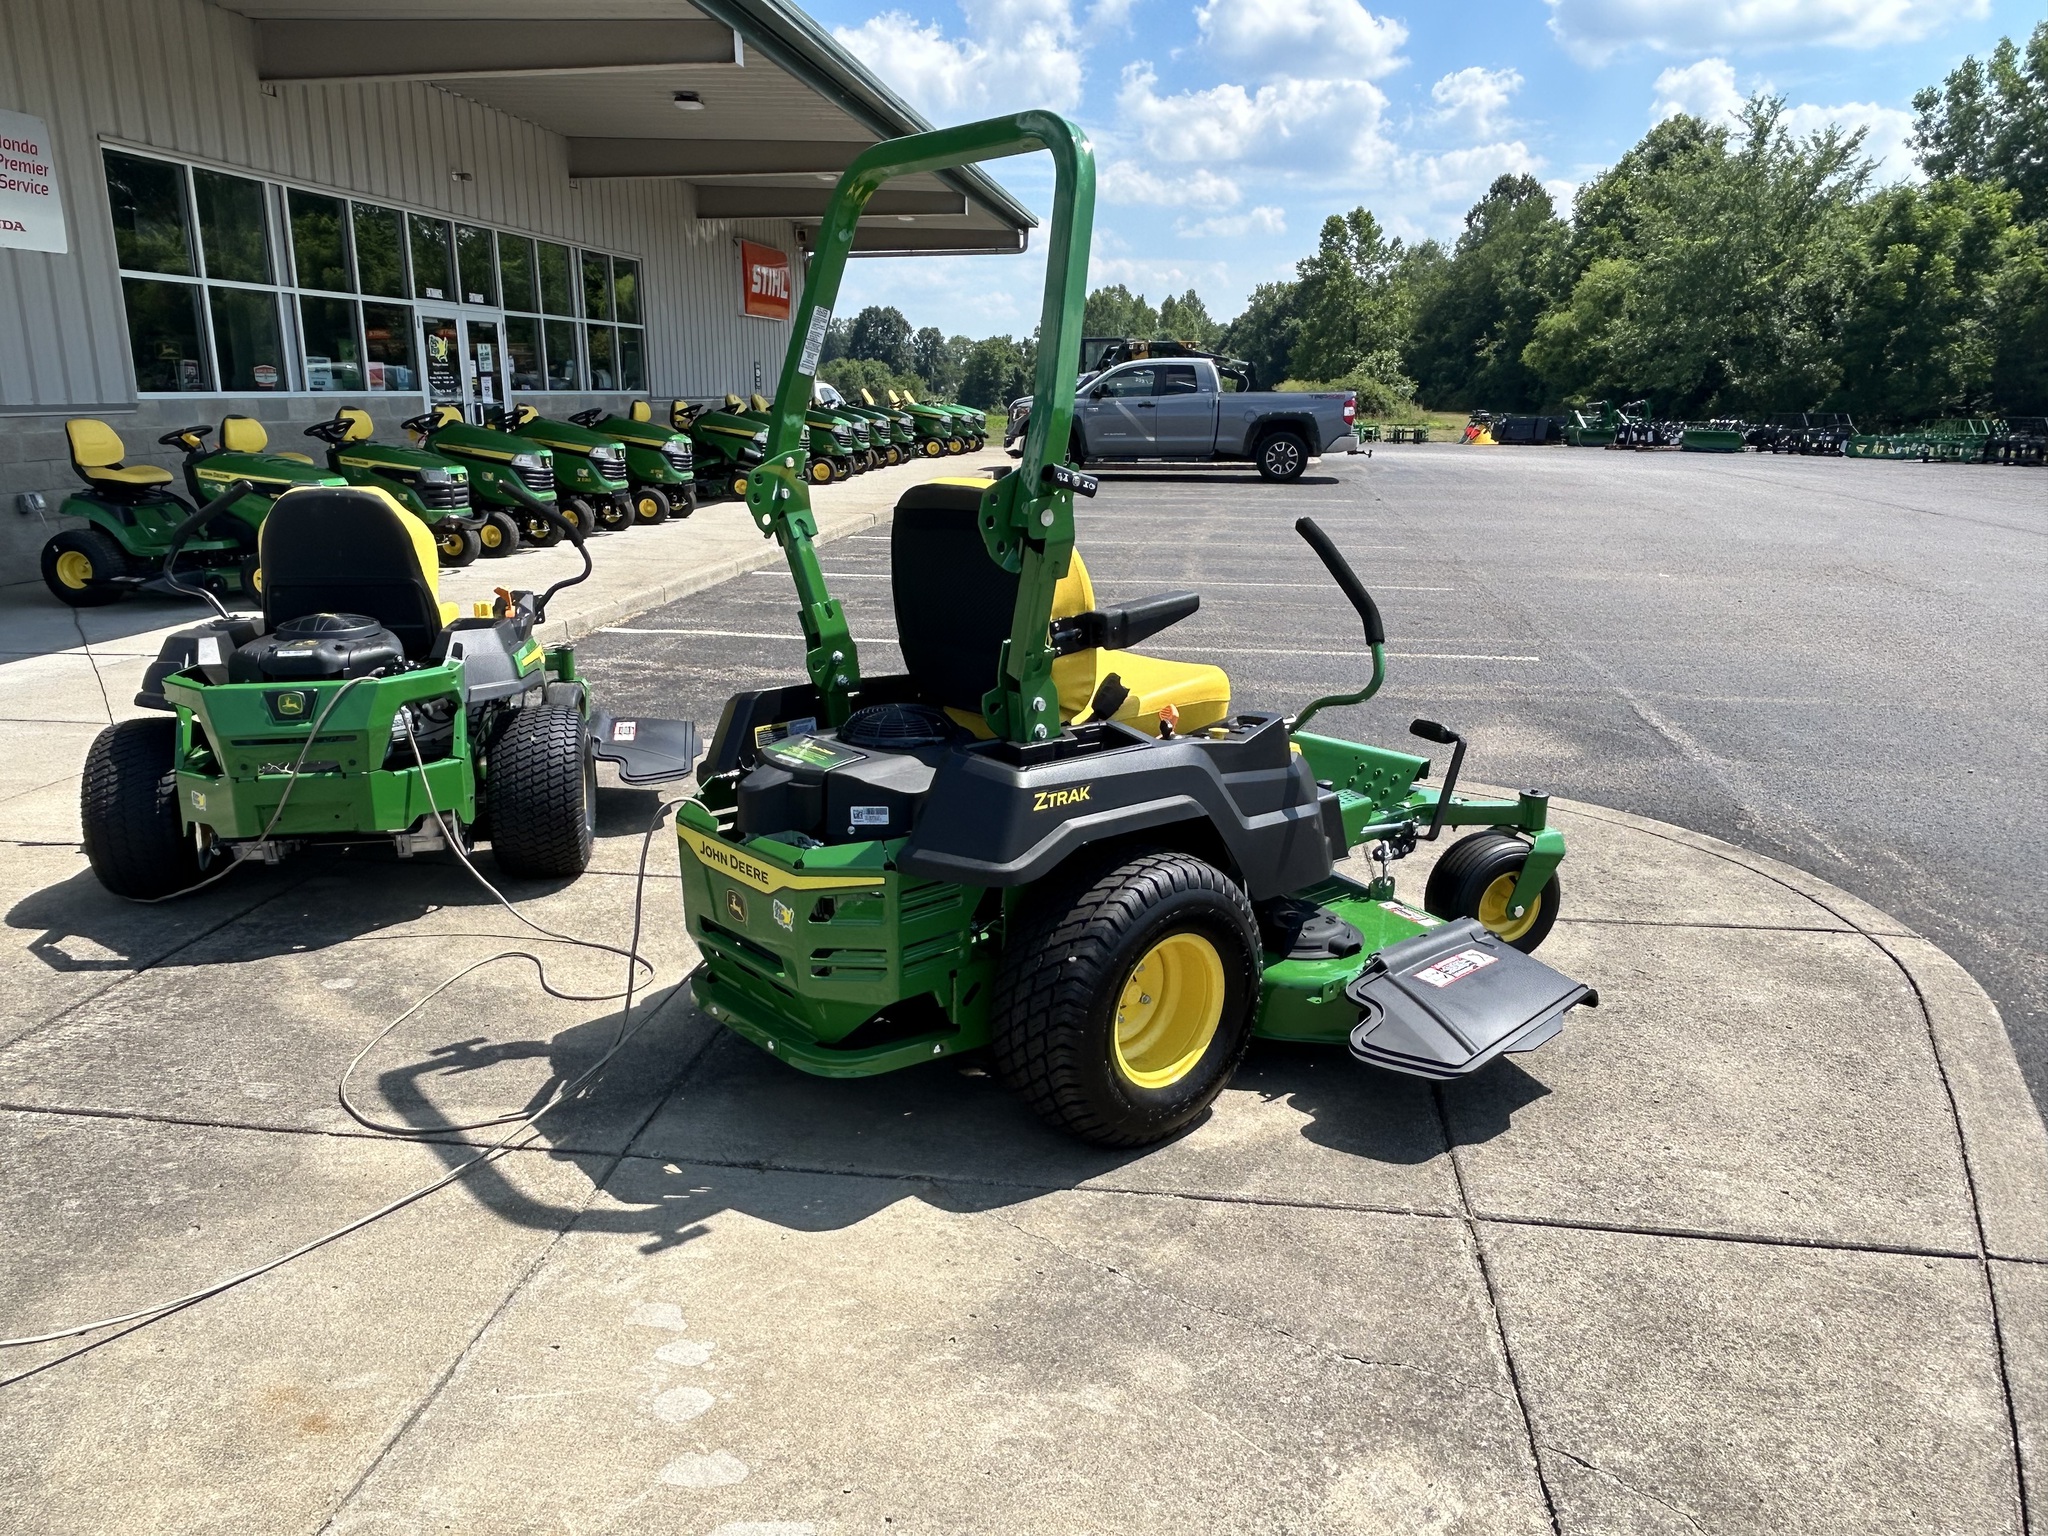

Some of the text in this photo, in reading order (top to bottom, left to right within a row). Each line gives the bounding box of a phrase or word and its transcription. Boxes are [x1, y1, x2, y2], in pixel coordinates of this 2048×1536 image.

[0, 134, 38, 156] onda
[0, 173, 49, 196] Service
[751, 264, 788, 299] STIHL
[1033, 785, 1090, 811] ZTRAK
[700, 840, 769, 885] JOHN DEERE
